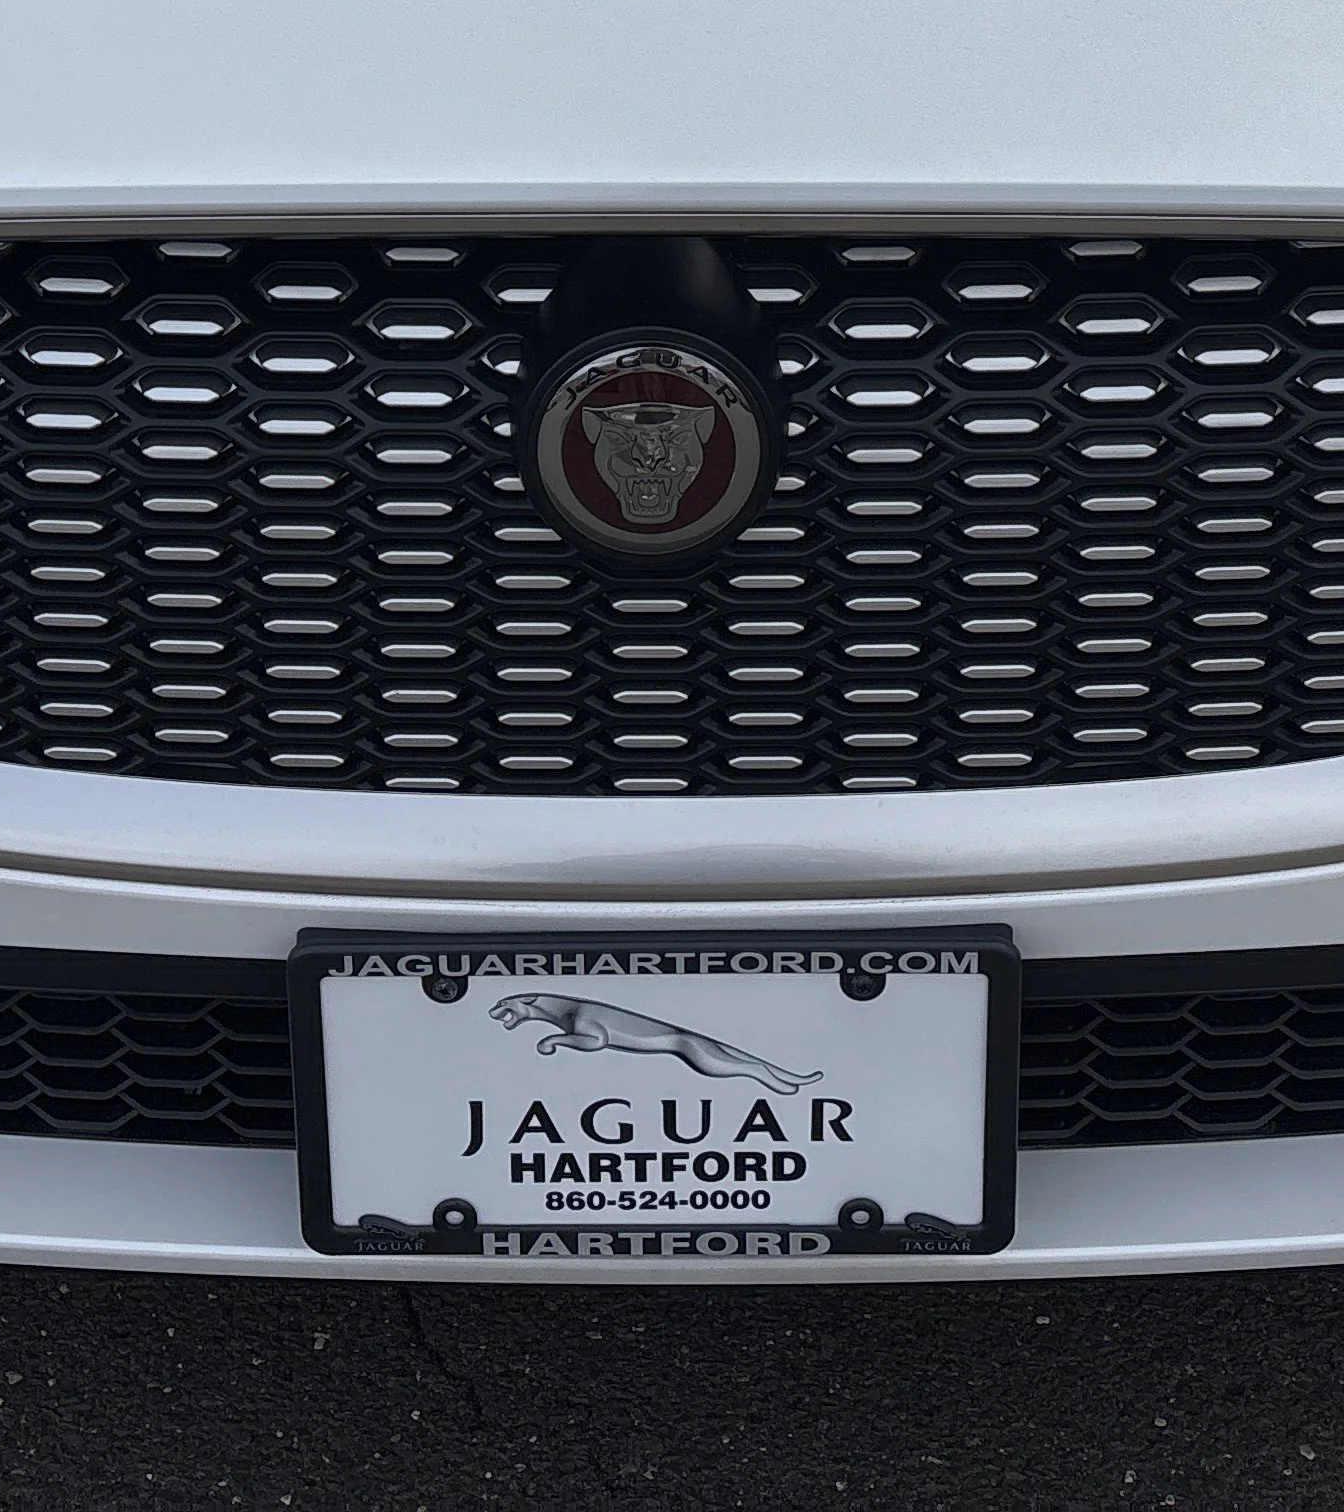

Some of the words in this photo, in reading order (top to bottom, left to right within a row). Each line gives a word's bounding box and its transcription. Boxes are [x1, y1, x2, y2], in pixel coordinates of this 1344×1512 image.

[564, 350, 739, 411] JAGUAR
[327, 950, 980, 978] JAGUARHARTFORD.COM
[460, 1097, 856, 1157] JAGUAR
[509, 1150, 807, 1184] HARTFORD
[544, 1188, 772, 1212] 860-524-0000
[357, 1240, 425, 1253] JAGUAR
[482, 1231, 832, 1257] HARTFORD
[904, 1240, 973, 1252] JAGUAR
